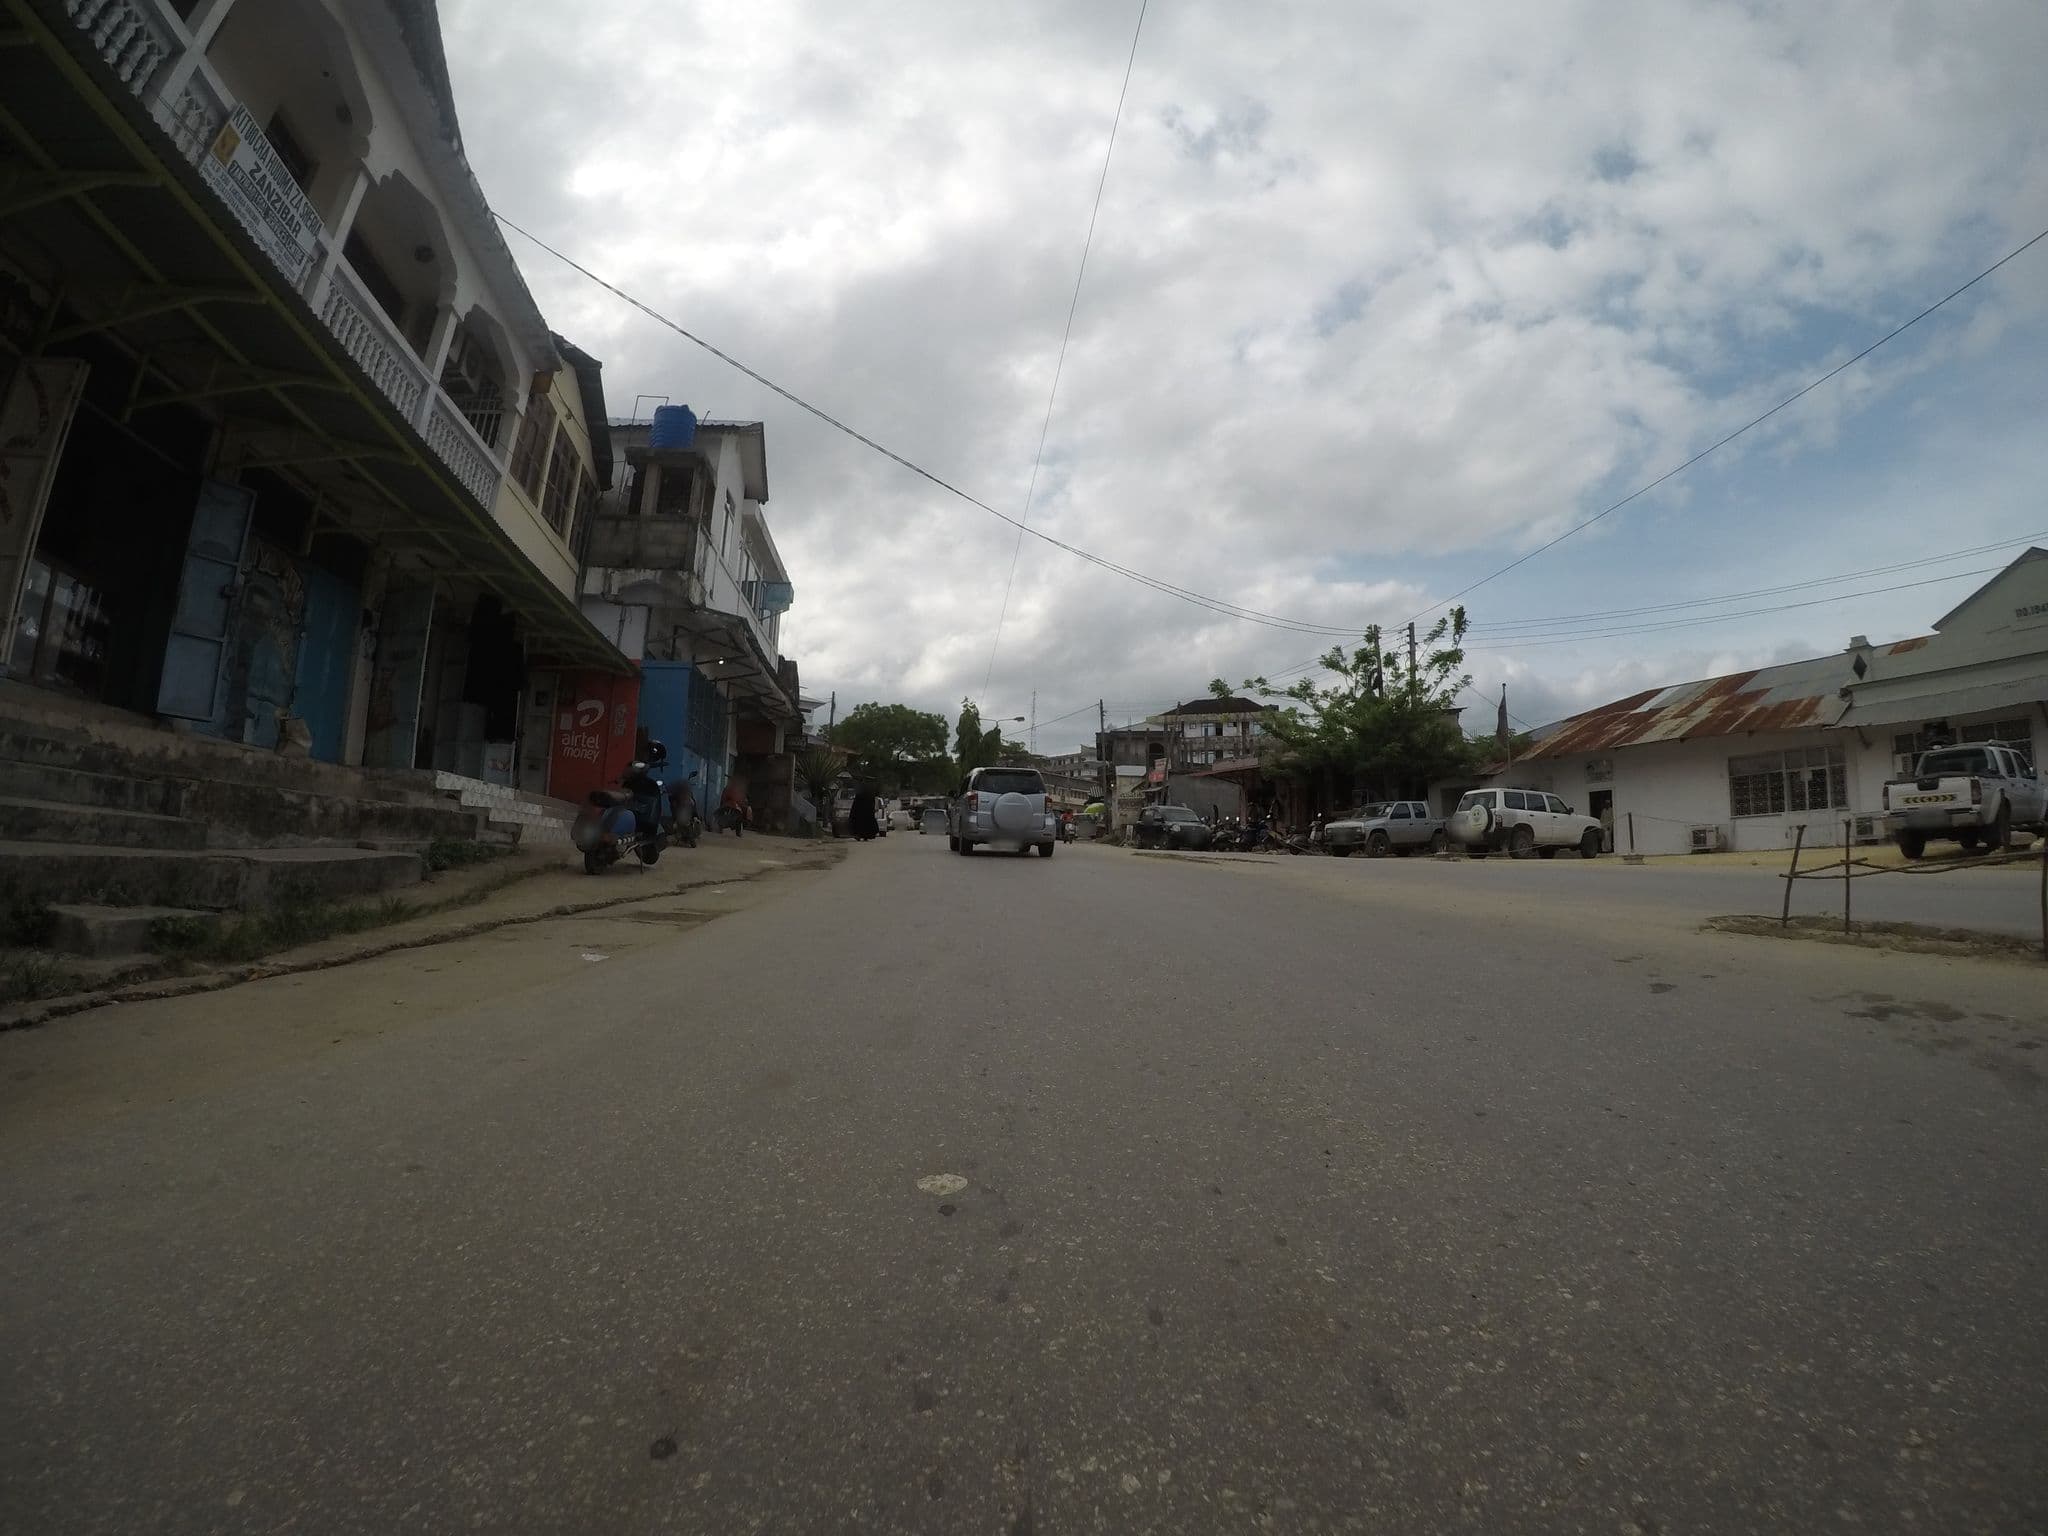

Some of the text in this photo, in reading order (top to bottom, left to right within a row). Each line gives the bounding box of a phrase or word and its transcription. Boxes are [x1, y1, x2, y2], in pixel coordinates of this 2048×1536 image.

[232, 105, 322, 238] KITUO CHA HUDUMA ZA SHERIA
[249, 164, 302, 237] ZANZIBAR
[562, 731, 600, 749] airtel
[563, 747, 600, 764] money
